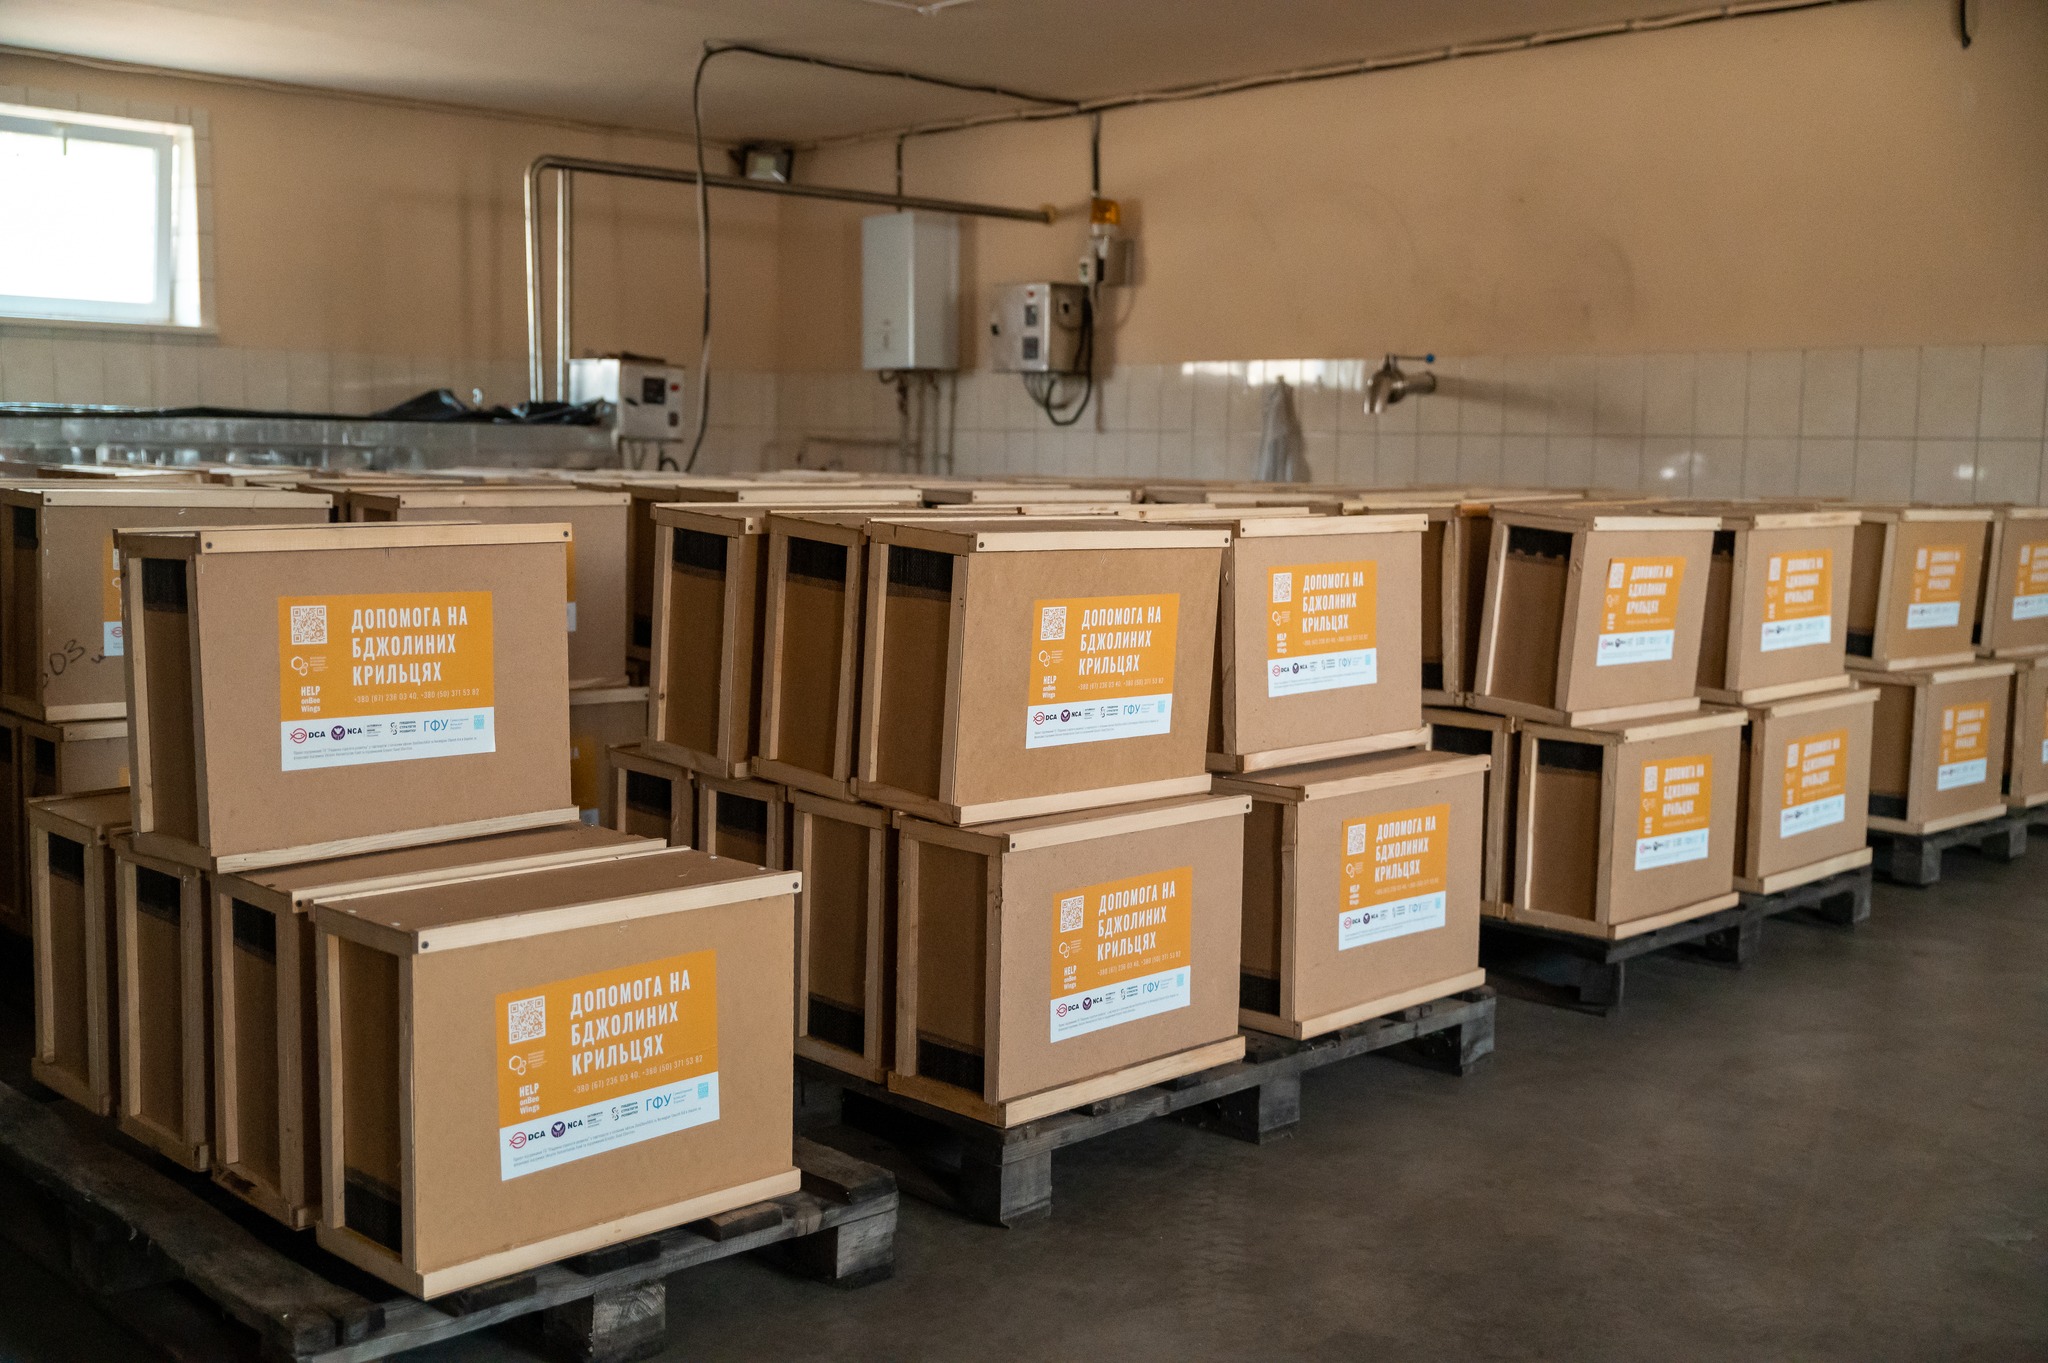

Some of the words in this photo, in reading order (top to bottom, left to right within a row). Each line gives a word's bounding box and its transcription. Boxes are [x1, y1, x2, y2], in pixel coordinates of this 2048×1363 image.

[1303, 572, 1349, 593] ДОПОМОГА
[1353, 571, 1363, 586] НА
[1303, 593, 1356, 614] БДЖОЛИНИХ
[352, 607, 440, 633] ДОПОМОГА
[448, 606, 468, 626] НА
[1081, 607, 1142, 630] ДОПОМОГА
[1148, 606, 1162, 623] НА
[1303, 614, 1348, 634] КРИЛЬЦЯХ
[352, 634, 456, 661] БДЖОЛИНИХ
[1080, 630, 1152, 654] БДЖОЛИНИХ
[353, 662, 442, 686] КРИЛЬЦЯХ
[1079, 654, 1140, 676] КРИЛЬЦЯХ
[1043, 675, 1057, 684] HELP
[301, 686, 320, 696] HELP
[301, 705, 320, 713] Wings
[1123, 704, 1141, 715] ГФУ
[423, 719, 449, 732] ГФУ
[1376, 818, 1421, 842] ДОПОМОГА
[1425, 815, 1436, 831] НА
[1376, 837, 1428, 863] БДЖОЛИНИХ
[1375, 859, 1420, 883] КРИЛЬЦЯХ
[1099, 884, 1157, 916] ДОПОМОГА
[1162, 880, 1175, 899] НА
[1098, 906, 1166, 939] БДЖОЛИНИХ
[1098, 932, 1156, 962] КРИЛЬЦЯХ
[1064, 965, 1076, 976] HELP
[571, 975, 662, 1019] ДОПОМОГА
[670, 969, 690, 993] НА
[1143, 981, 1160, 995] ГФУ
[1068, 1004, 1079, 1012] DCA
[572, 1001, 678, 1047] БДЖОЛИНИХ
[572, 1034, 664, 1076] КРИЛЬЦЯХ
[574, 1084, 590, 1094] +380
[592, 1079, 605, 1091] (67)
[685, 1057, 693, 1066] 53
[519, 1083, 539, 1097] HELP
[520, 1095, 540, 1106] onBee
[520, 1103, 540, 1116] Wings
[646, 1093, 671, 1112] ГФУ
[568, 1119, 583, 1129] NCA
[528, 1130, 545, 1141] DCA
